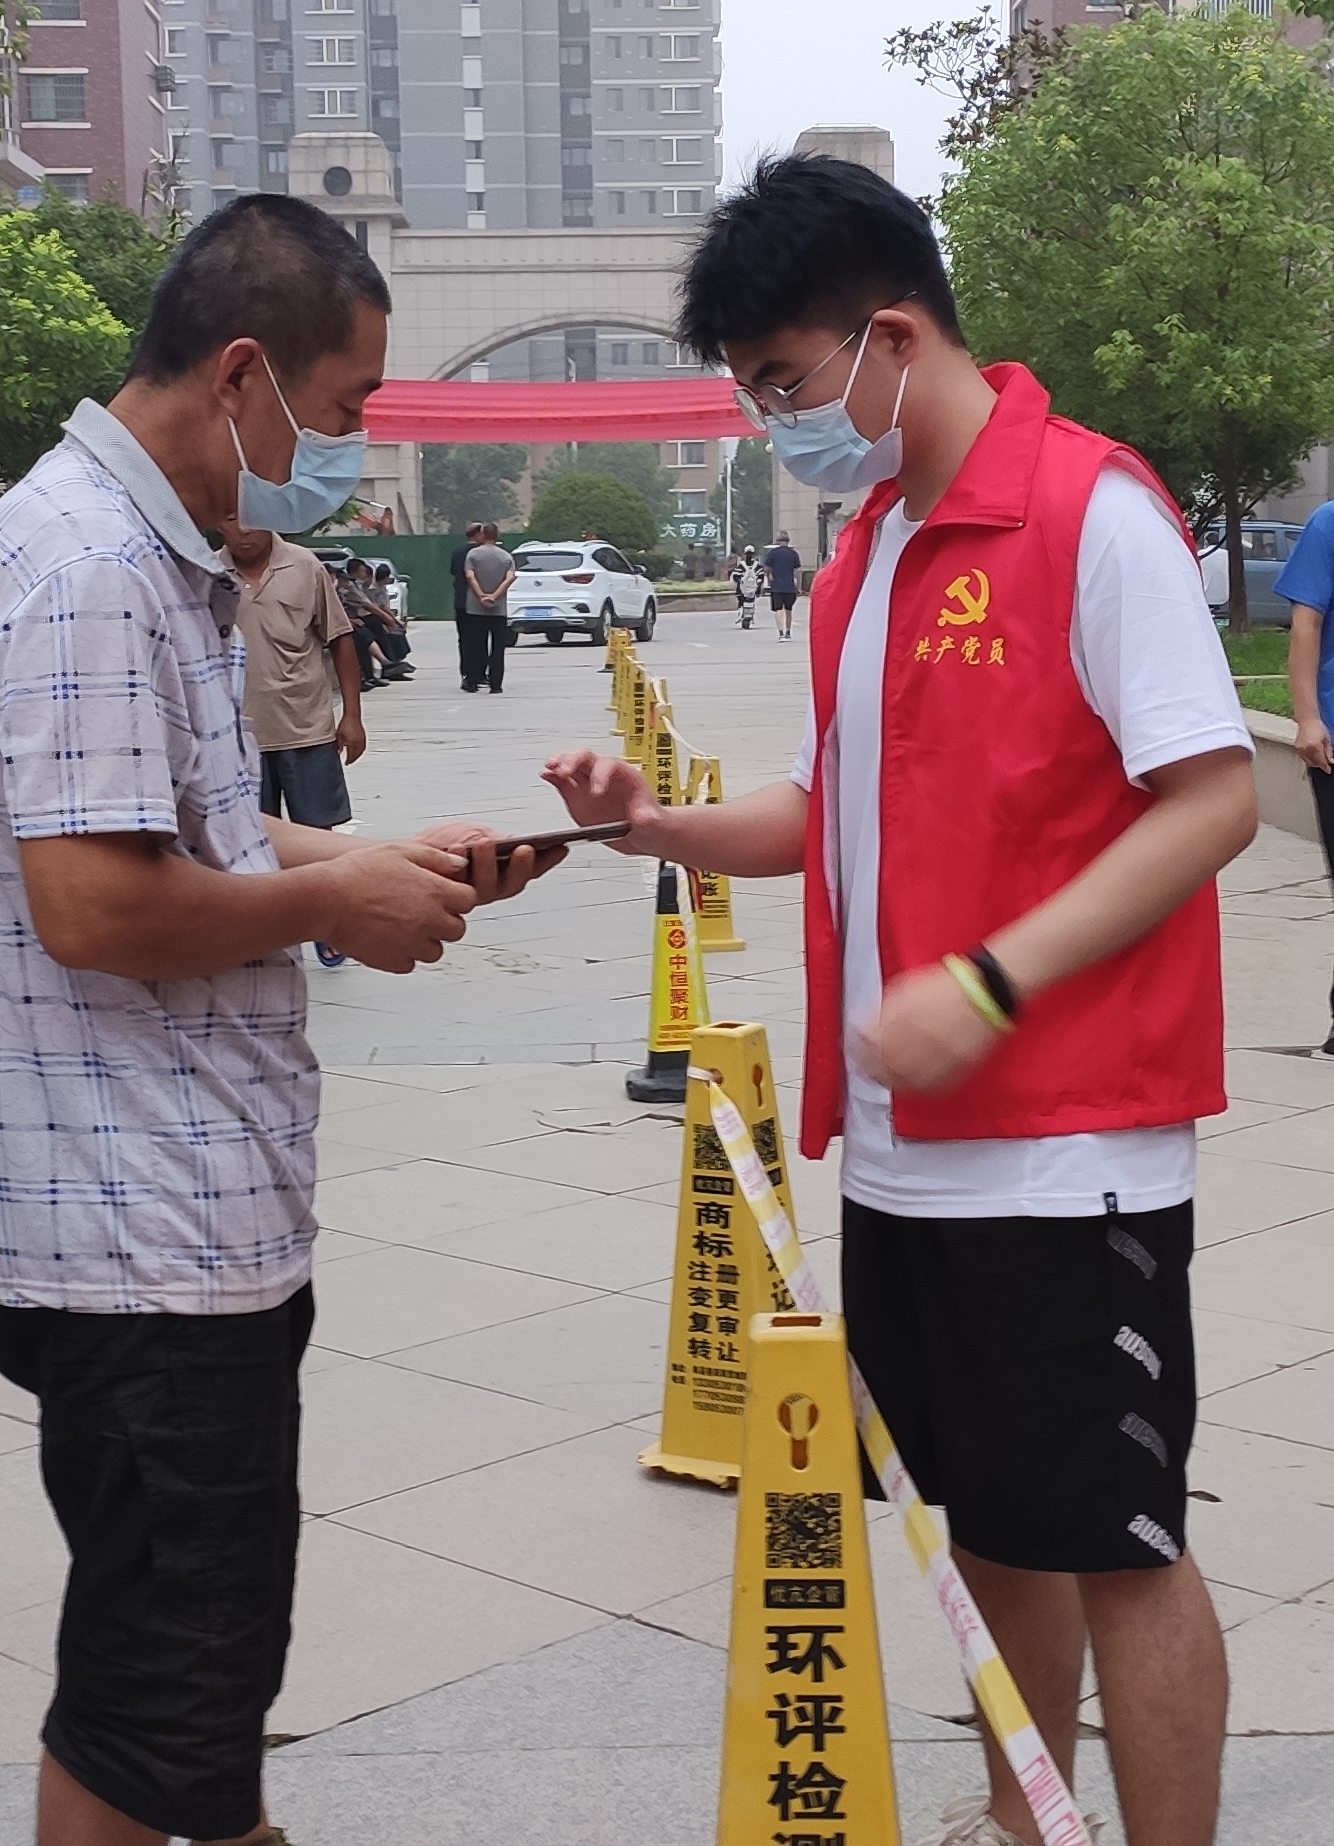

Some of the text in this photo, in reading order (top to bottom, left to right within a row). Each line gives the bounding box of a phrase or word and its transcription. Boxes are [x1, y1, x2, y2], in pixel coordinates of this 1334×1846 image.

[660, 522, 718, 538] 大药房
[914, 635, 1005, 666] 共产党员
[669, 953, 689, 1020] 中恒聚财
[692, 1201, 734, 1259] 商标
[687, 1261, 740, 1285] 注册
[687, 1286, 740, 1311] 变更
[687, 1312, 740, 1337] 复审
[687, 1337, 740, 1362] 转让
[765, 1625, 847, 1846] 环评检
